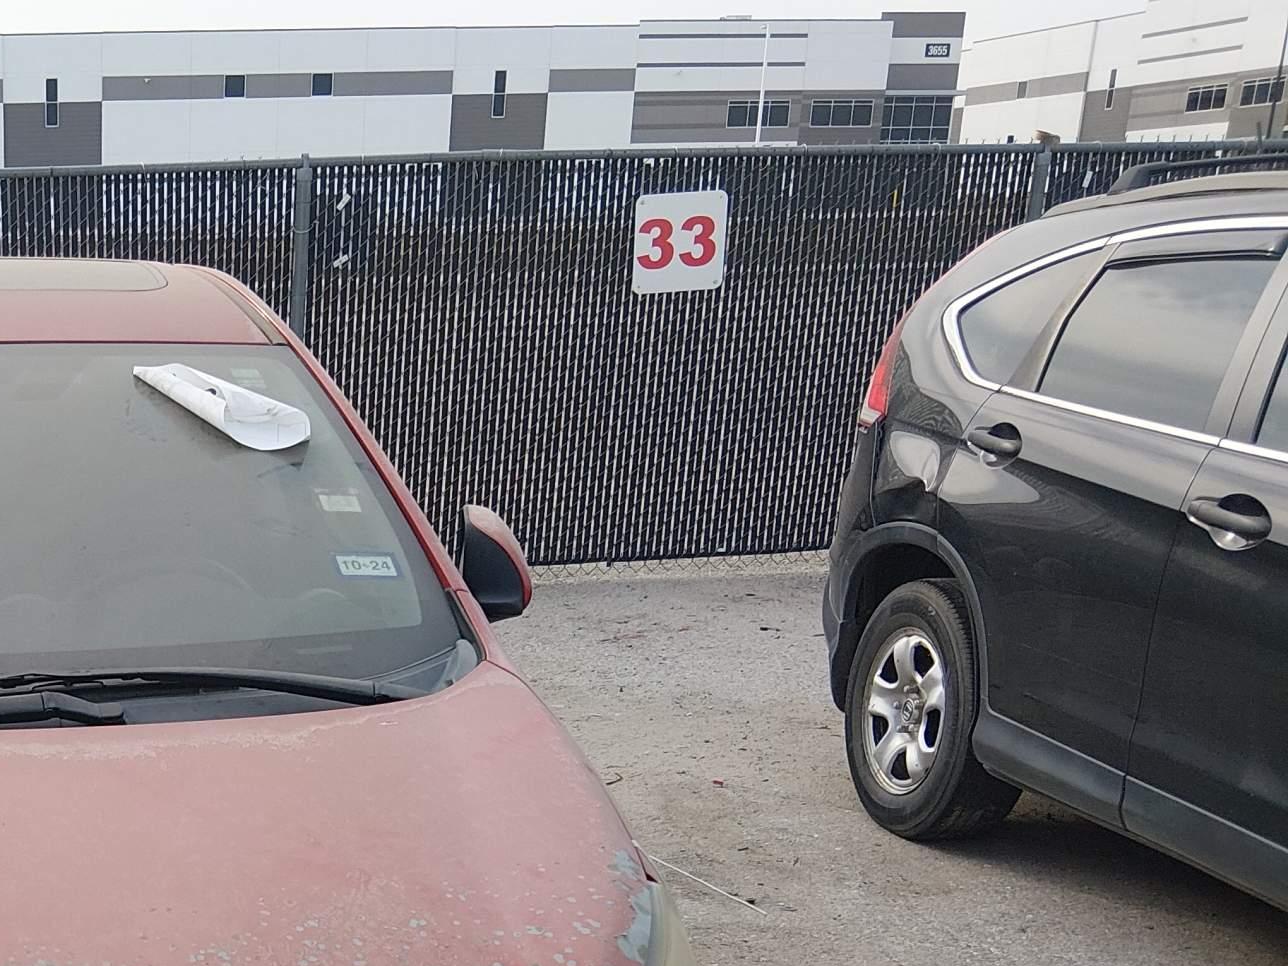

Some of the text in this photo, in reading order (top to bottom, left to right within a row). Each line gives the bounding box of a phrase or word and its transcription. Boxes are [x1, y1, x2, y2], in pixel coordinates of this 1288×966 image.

[927, 44, 948, 56] 3655
[636, 215, 717, 270] 33
[341, 559, 392, 571] 10-24
